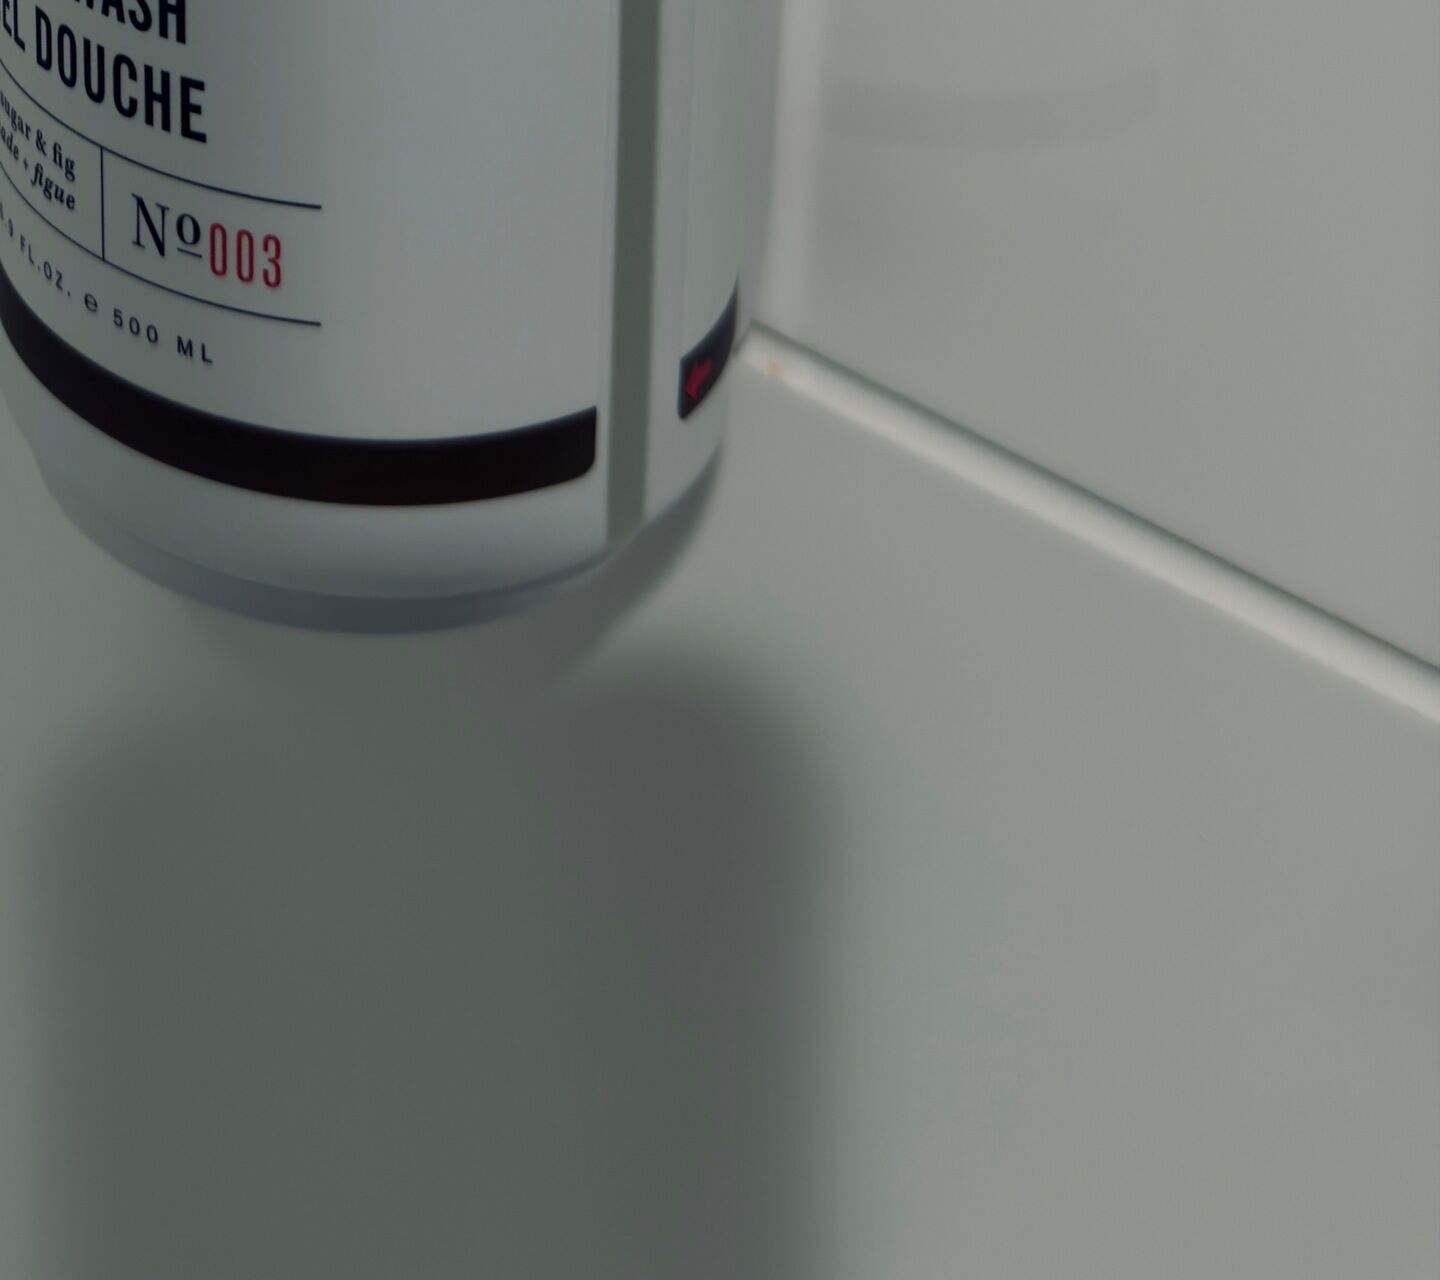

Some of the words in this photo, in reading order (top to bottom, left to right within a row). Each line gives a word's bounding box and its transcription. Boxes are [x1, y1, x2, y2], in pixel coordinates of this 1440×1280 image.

[34, 4, 208, 144] DOUCHE
[0, 89, 32, 141] sugar
[35, 128, 48, 158] &
[51, 140, 77, 183] fig
[30, 161, 77, 211] figue
[112, 307, 160, 345] 500
[176, 335, 213, 365] ML
